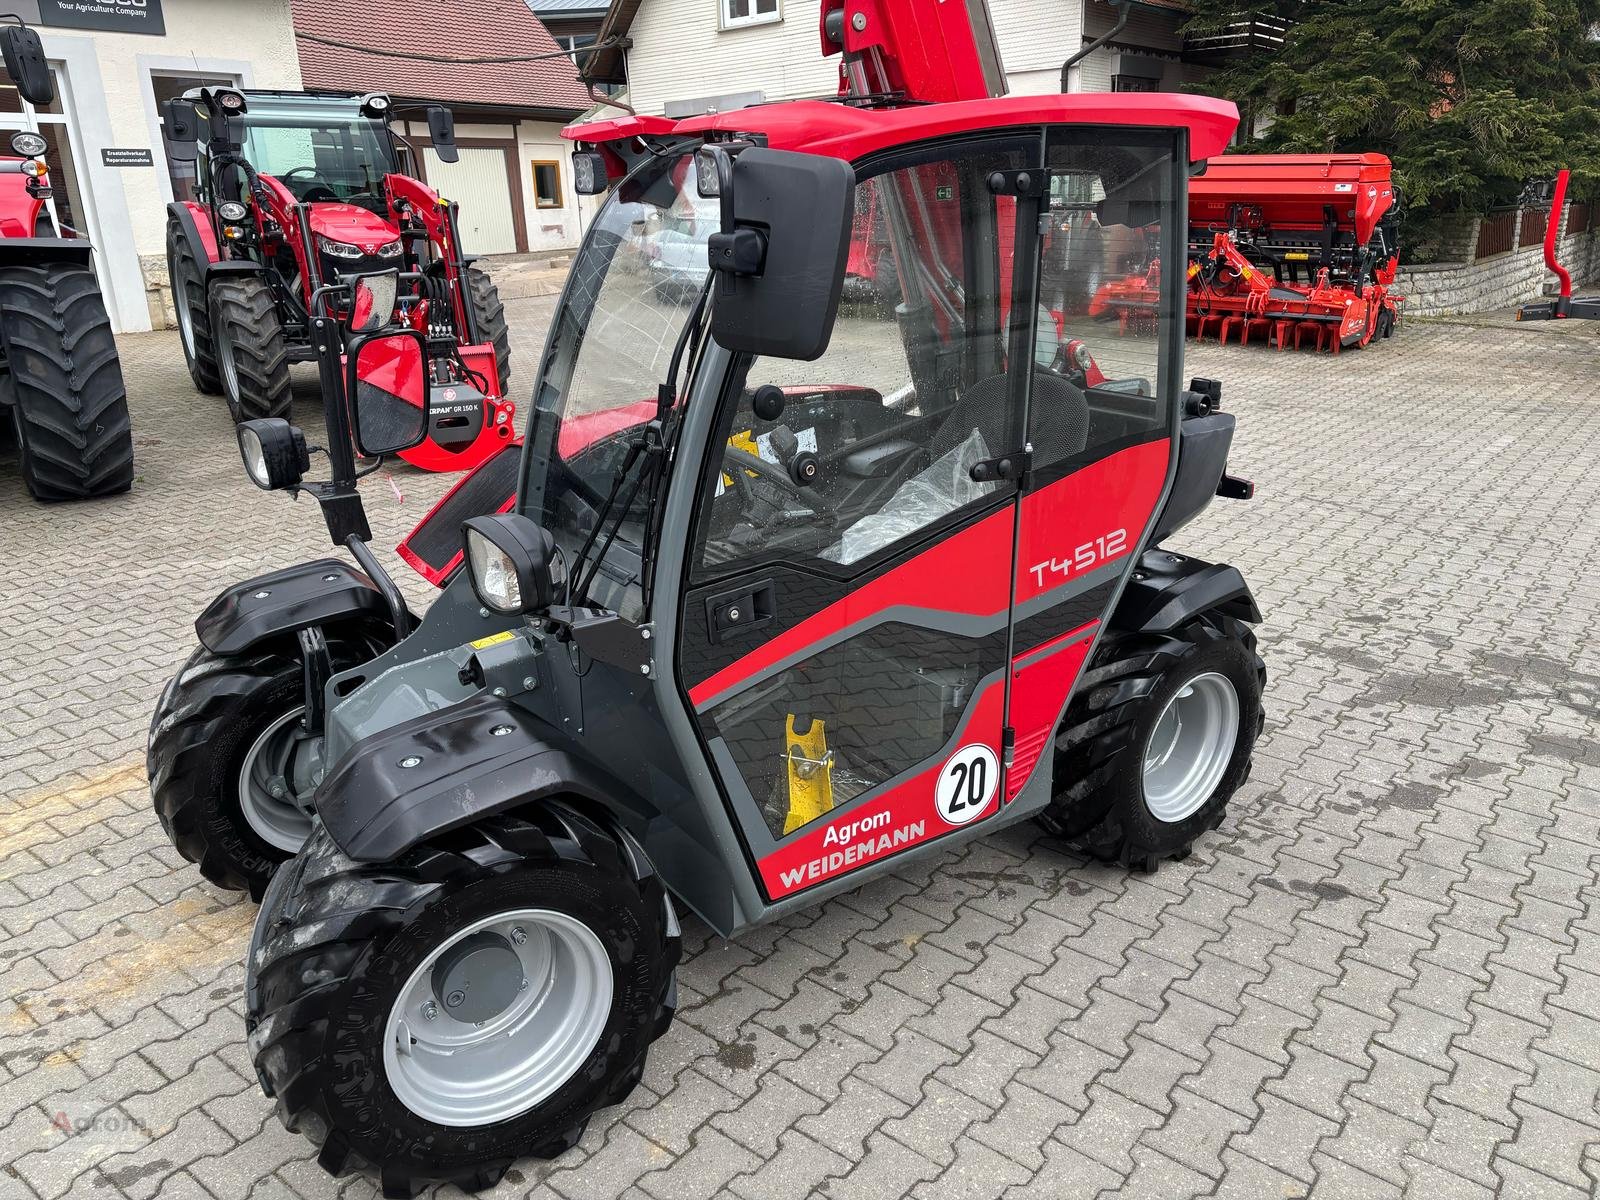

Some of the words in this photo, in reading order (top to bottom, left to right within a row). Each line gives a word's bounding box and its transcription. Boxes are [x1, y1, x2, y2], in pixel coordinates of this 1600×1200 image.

[57, 1, 75, 10] Your
[75, 4, 114, 14] Agriculture
[115, 6, 147, 17] Company
[948, 757, 987, 814] 20
[823, 810, 892, 848] Agrom
[779, 819, 926, 889] WEIDEMANN
